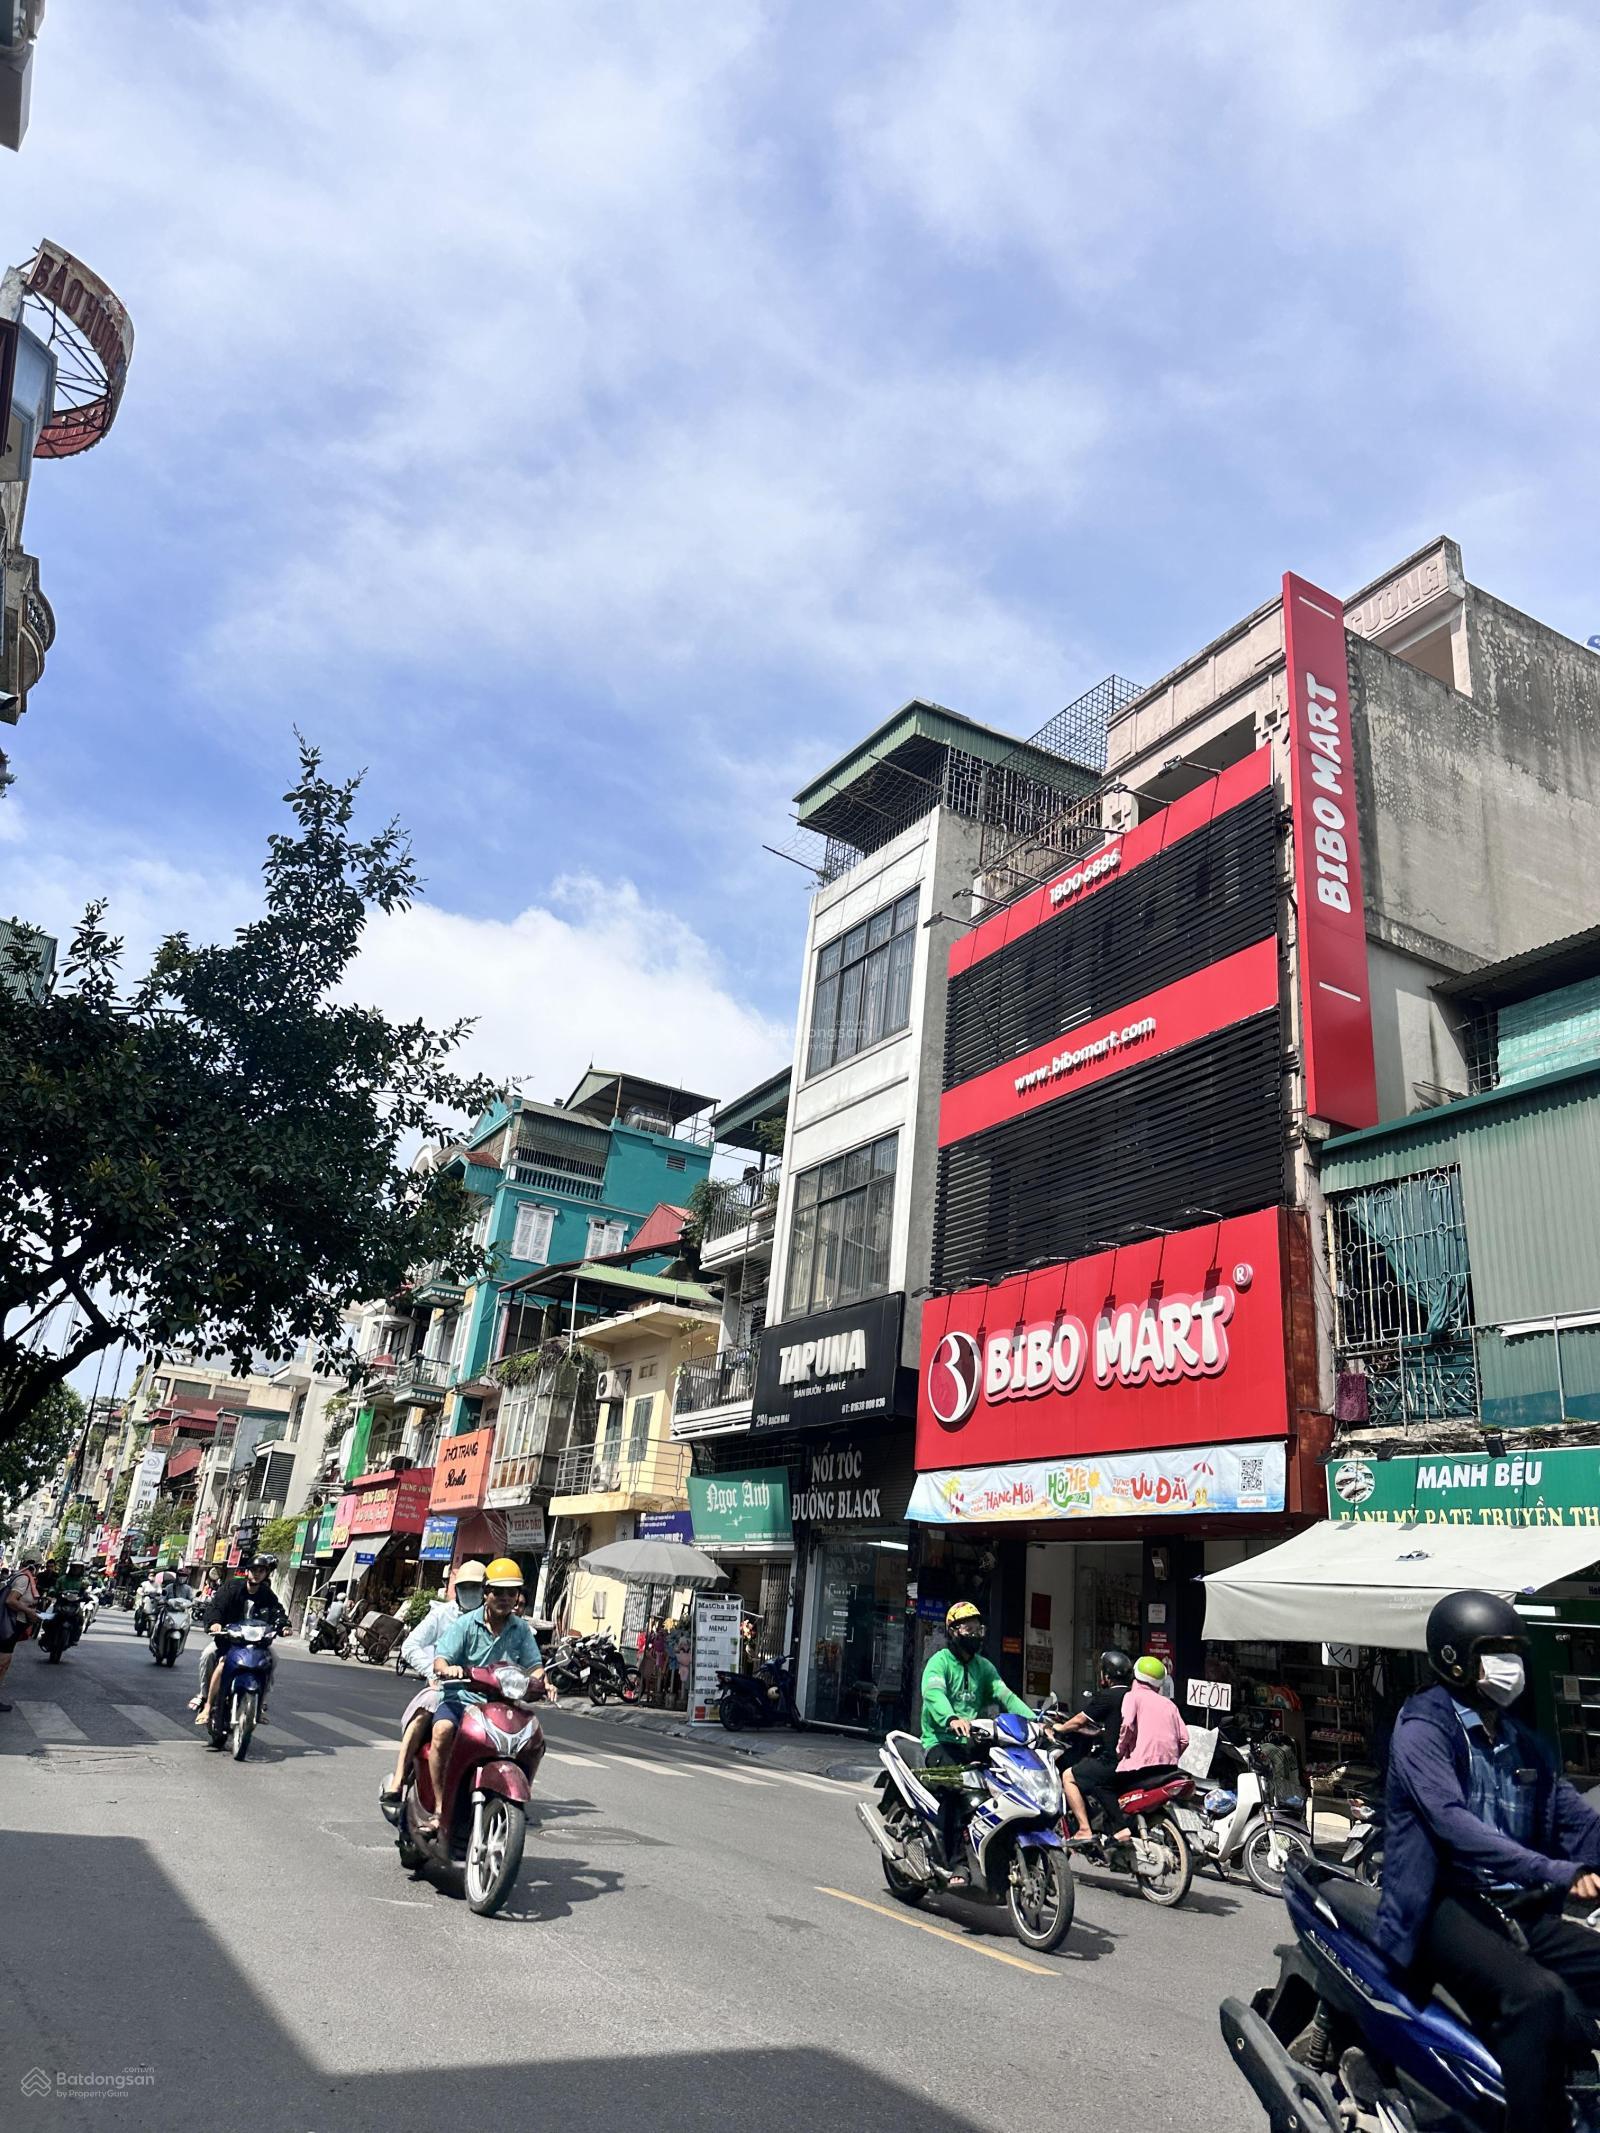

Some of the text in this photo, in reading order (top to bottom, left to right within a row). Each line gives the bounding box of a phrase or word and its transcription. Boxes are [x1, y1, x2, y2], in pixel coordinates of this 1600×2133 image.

[1306, 672, 1352, 914] BIBO MART
[1014, 1017, 1157, 1092] www.bibomart.com
[779, 1329, 866, 1386] TAPUNA
[984, 1322, 1083, 1397] BIBO
[1096, 1294, 1227, 1380] MART
[811, 1443, 862, 1483] NỐI TÓC
[1417, 1456, 1542, 1496] MẠNH BỆU
[838, 1489, 880, 1519] BLACK
[1190, 1683, 1208, 1705] XE
